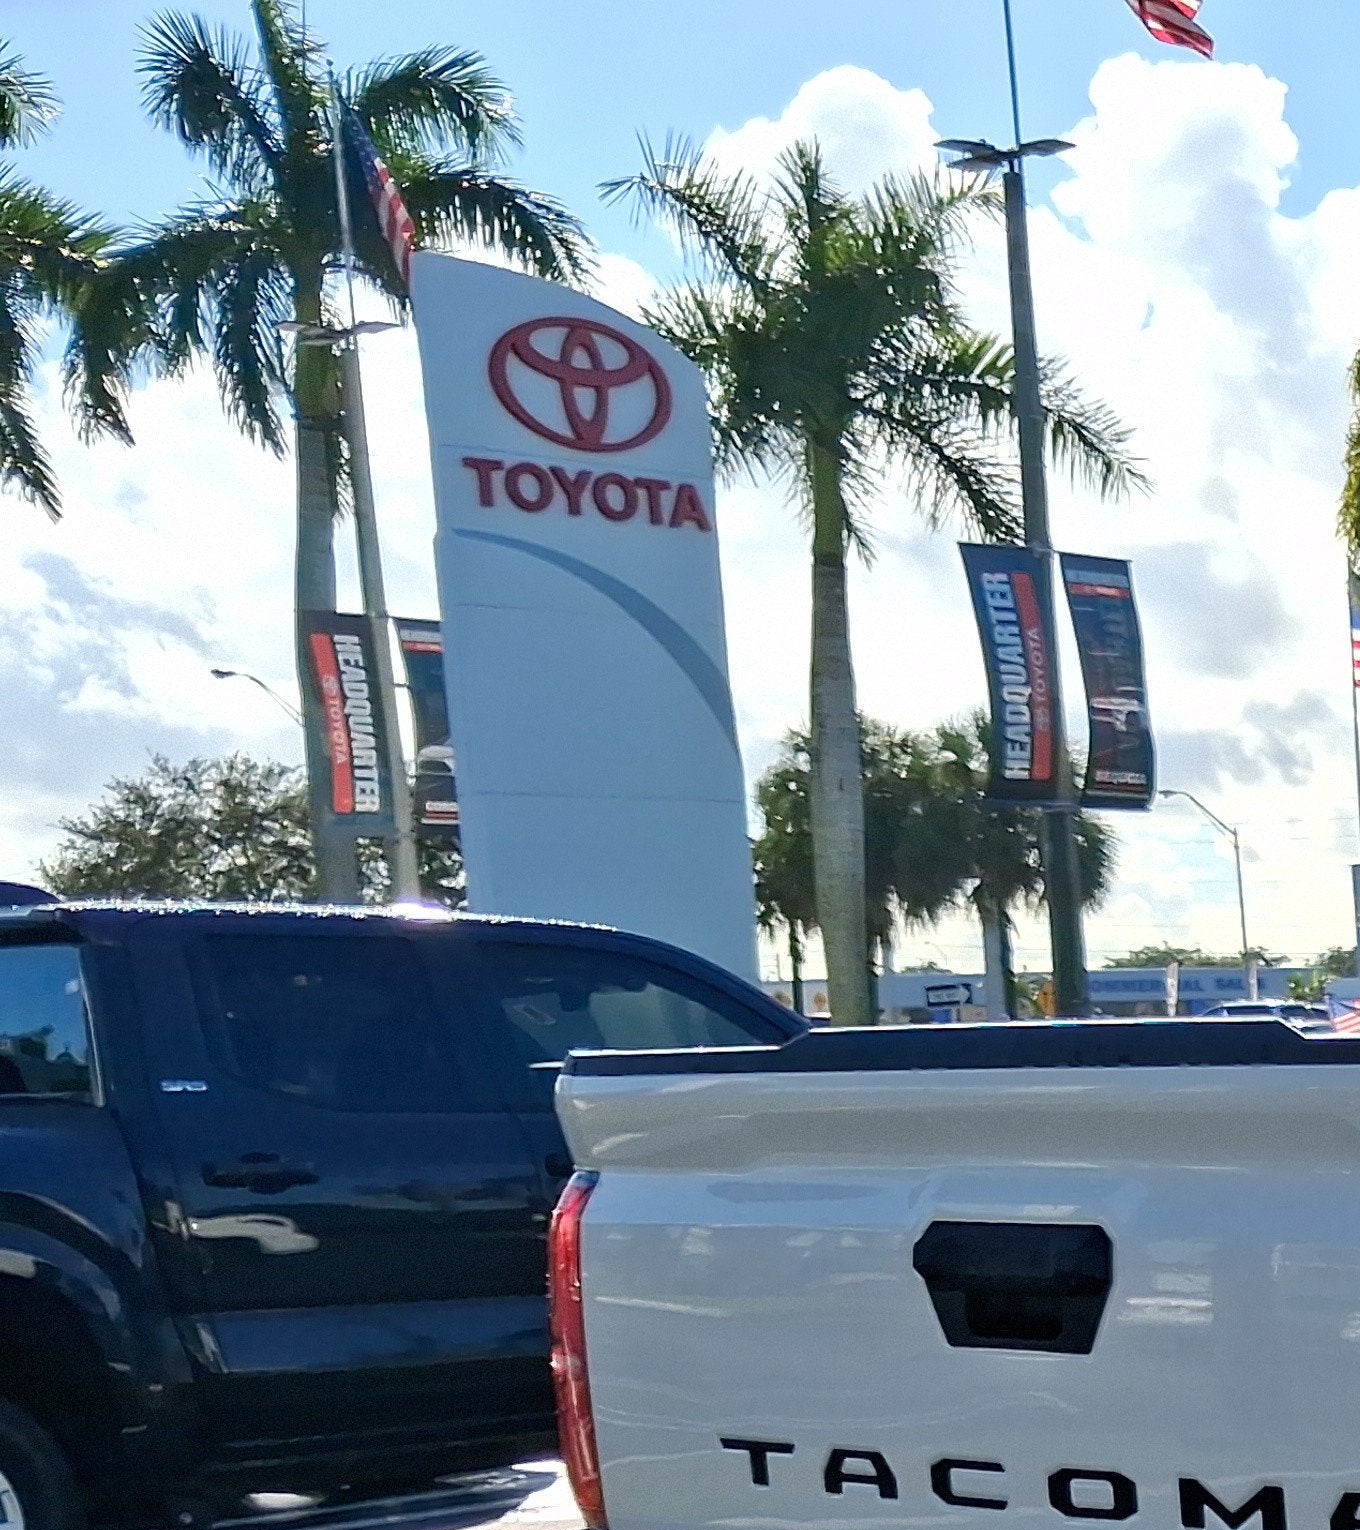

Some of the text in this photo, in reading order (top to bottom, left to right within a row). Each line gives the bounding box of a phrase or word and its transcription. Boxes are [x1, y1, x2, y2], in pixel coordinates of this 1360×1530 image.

[462, 456, 712, 532] TOYOTA
[333, 634, 380, 812] HEADQUARTER
[982, 572, 1031, 780] HEADQUARTER
[1028, 627, 1047, 709] TOYOTA
